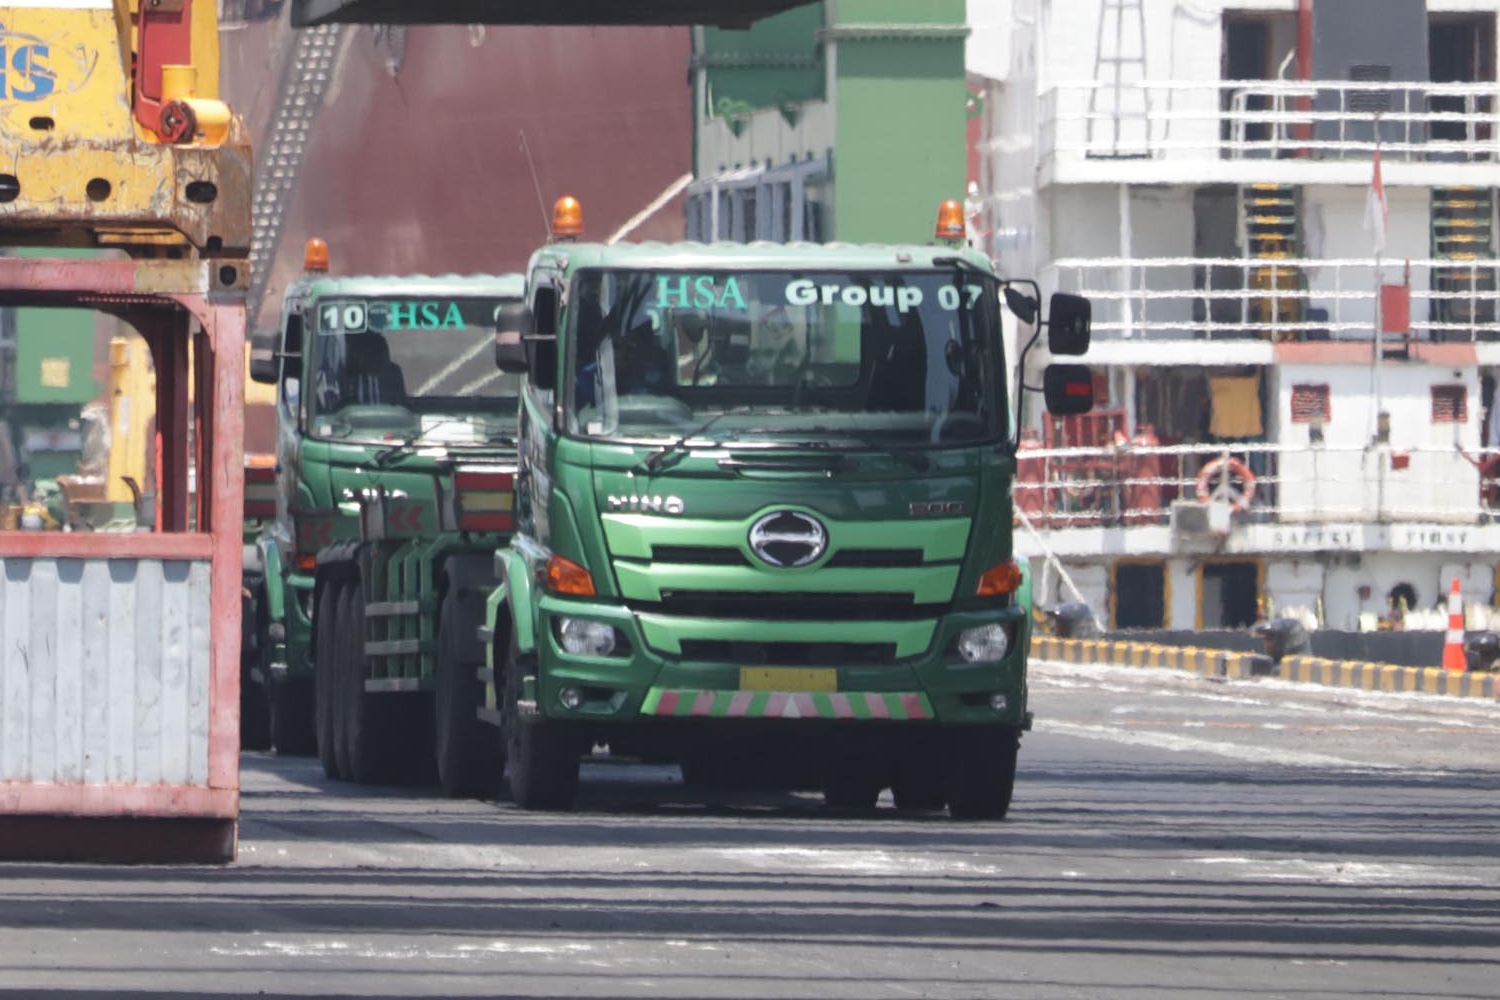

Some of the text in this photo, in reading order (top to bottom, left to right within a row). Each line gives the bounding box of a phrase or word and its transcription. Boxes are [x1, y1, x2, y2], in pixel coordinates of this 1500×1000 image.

[656, 275, 984, 313] HSA Group 07
[323, 306, 367, 329] 10
[389, 302, 467, 331] HSA
